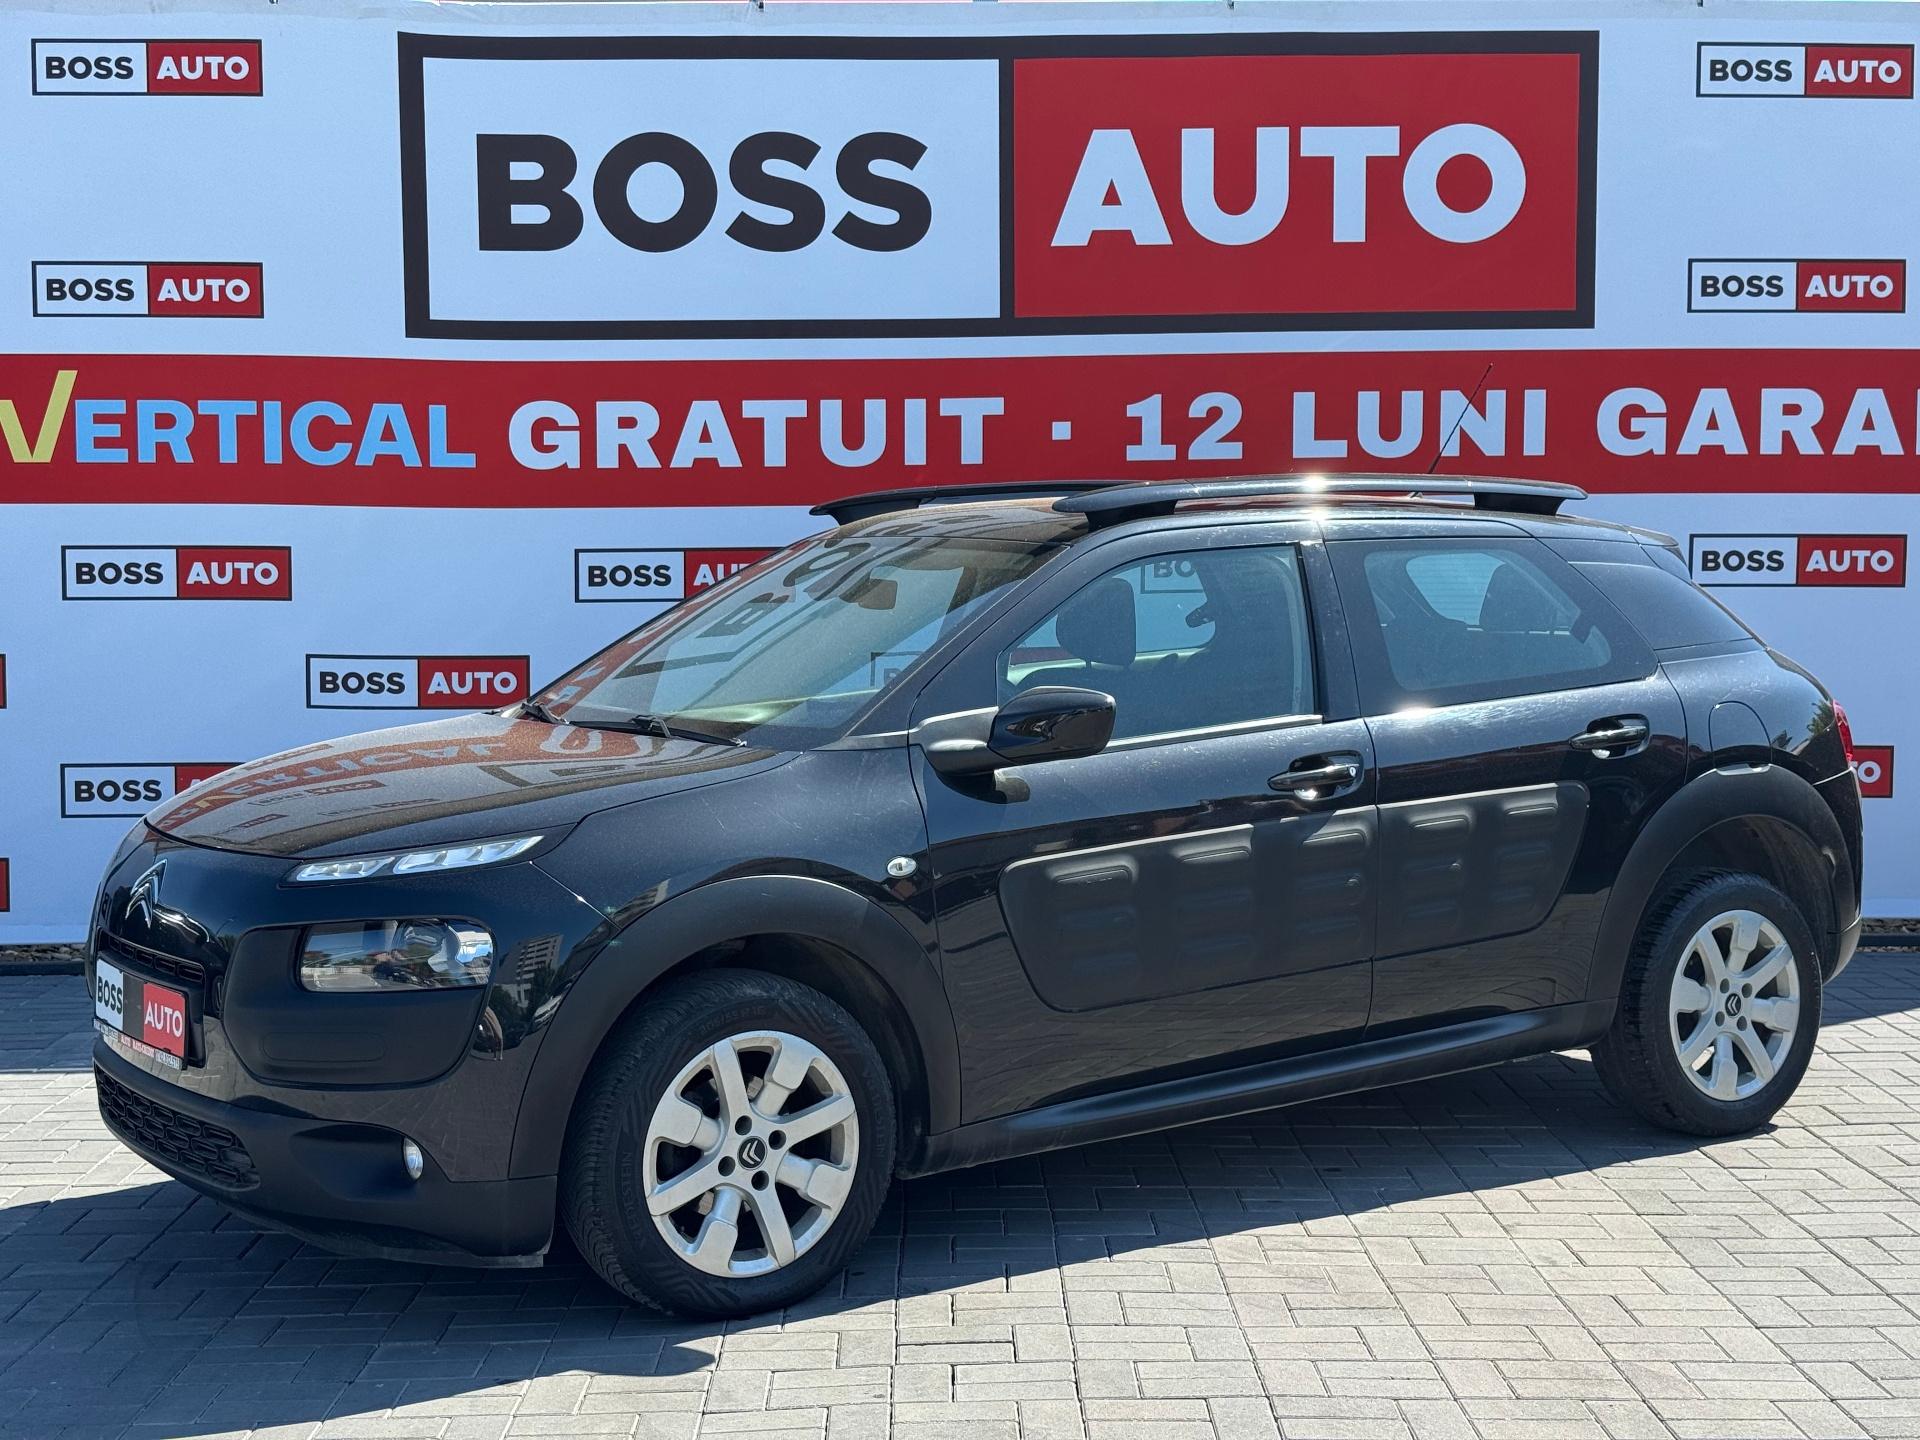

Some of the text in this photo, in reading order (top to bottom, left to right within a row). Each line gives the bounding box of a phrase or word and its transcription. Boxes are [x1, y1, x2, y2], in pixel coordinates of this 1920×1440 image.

[45, 56, 250, 80] BOSS AUTO
[1709, 59, 1902, 84] BOSS AUTO
[476, 123, 1527, 253] BOSS AUTO
[46, 278, 251, 302] BOSS AUTO
[1700, 274, 1894, 298] BOSS AUTO
[0, 369, 477, 468] VERTICAL
[508, 396, 1005, 471] GRATUIT
[1126, 391, 1243, 462] 12
[1292, 389, 1547, 459] LUNI
[1596, 387, 1920, 457] GARA
[1701, 549, 1894, 573] BOSS AUTO
[75, 561, 279, 586] BOSS AUTO
[587, 564, 672, 588] BOSS
[318, 670, 518, 695] BOSS AUTO
[74, 779, 163, 803] BOSS
[97, 976, 123, 1015] BOSS
[144, 1000, 183, 1038] AUTO
